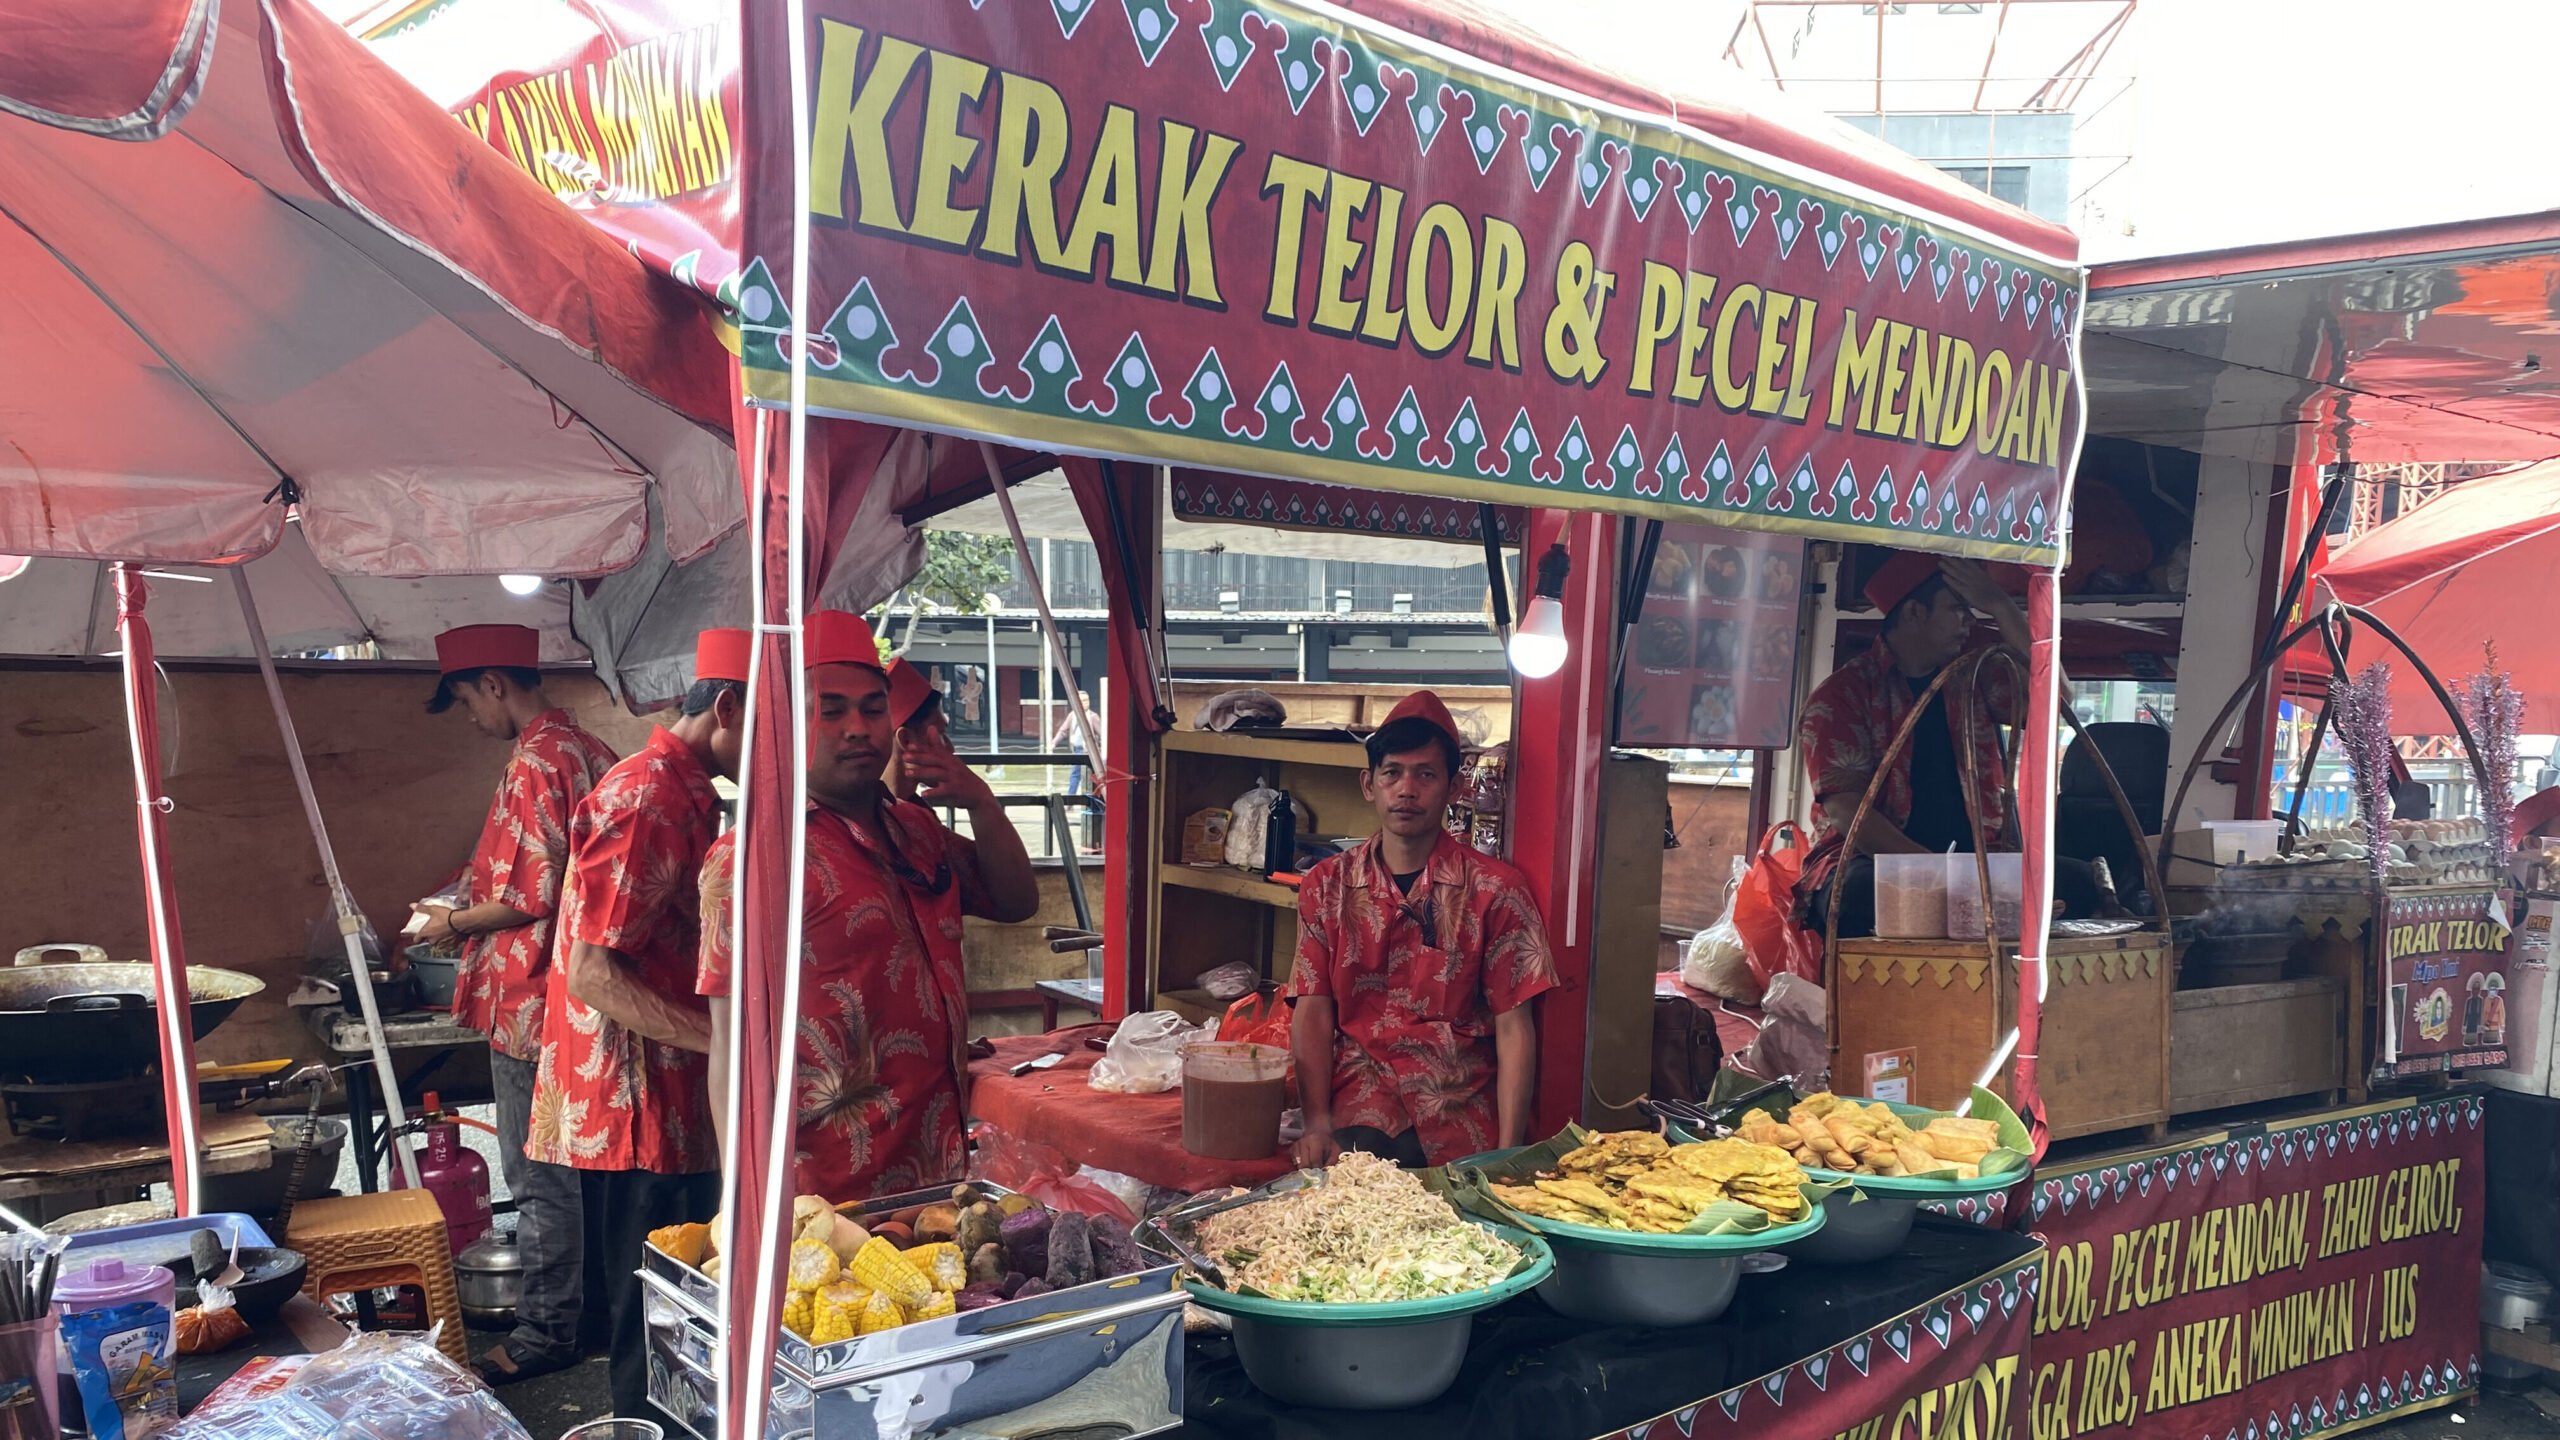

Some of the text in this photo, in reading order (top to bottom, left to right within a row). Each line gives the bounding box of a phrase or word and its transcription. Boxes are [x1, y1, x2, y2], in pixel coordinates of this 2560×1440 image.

[809, 17, 2069, 467] KERAK TELOR & PECEL MENDOAN
[2389, 921, 2443, 959] ERAK
[2447, 920, 2511, 953] TELOR
[2102, 1219, 2181, 1317] PECEL
[2180, 1189, 2311, 1295] MENDOAN,
[2319, 1175, 2380, 1259] TAHU
[2380, 1158, 2462, 1243] GEJROT,
[108, 1332, 139, 1358] GARAM
[2028, 1263, 2419, 1440] GA IRIS, ANEKA MINUMAN / JUS
